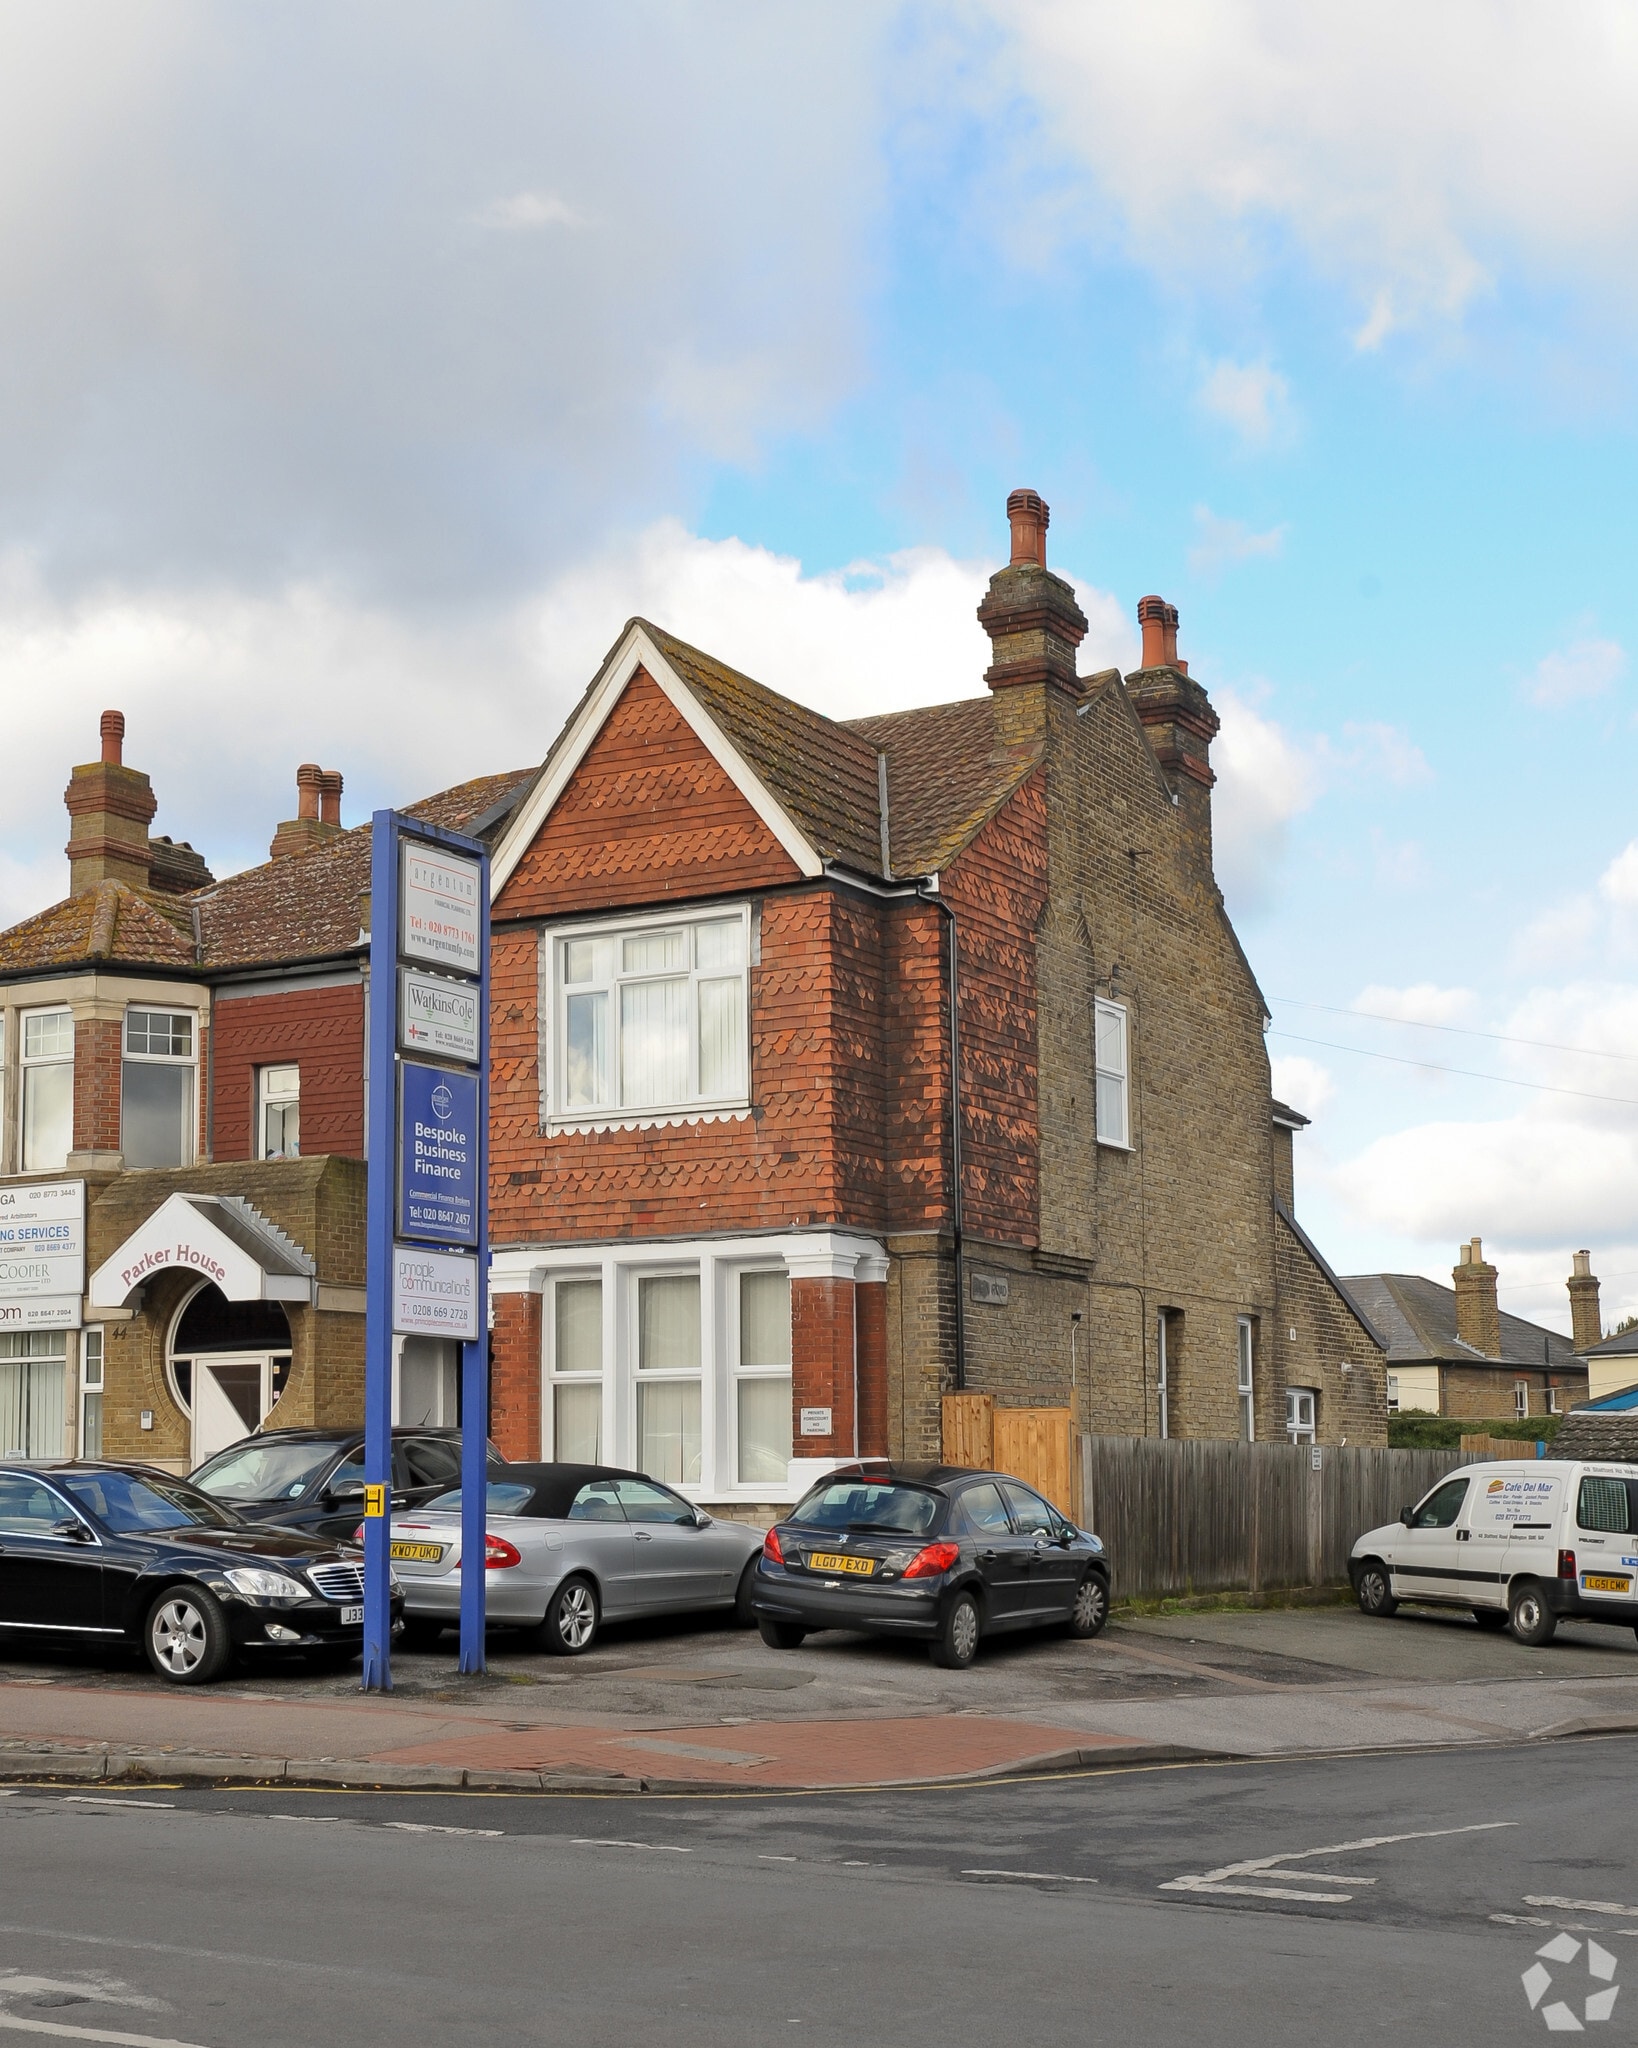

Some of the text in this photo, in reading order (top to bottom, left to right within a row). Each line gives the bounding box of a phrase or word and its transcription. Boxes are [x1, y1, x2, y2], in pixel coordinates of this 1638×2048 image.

[414, 868, 472, 895] argentum
[428, 921, 442, 934] 020
[444, 925, 458, 940] 8773
[462, 930, 474, 944] 1761
[411, 934, 474, 958] www.argentumfp.com
[412, 988, 472, 1021] WatkinsCole
[415, 1122, 466, 1145] Bespoke
[415, 1141, 466, 1162] Business
[415, 1159, 460, 1180] Finance
[44, 1190, 58, 1198] 8773
[410, 1206, 422, 1218] Tel:
[423, 1208, 436, 1220] 020
[438, 1210, 454, 1222] 8647
[18, 1226, 70, 1240] SERVICES
[121, 1244, 226, 1287] Parker House
[402, 1277, 470, 1296] communications
[402, 1303, 468, 1320] T: 0208 669 2728
[112, 1326, 128, 1340] 44
[1524, 1482, 1536, 1492] Del
[1537, 1482, 1553, 1492] Mar
[392, 1544, 439, 1559] KW07 UKD
[815, 1555, 868, 1572] LG07 EXD
